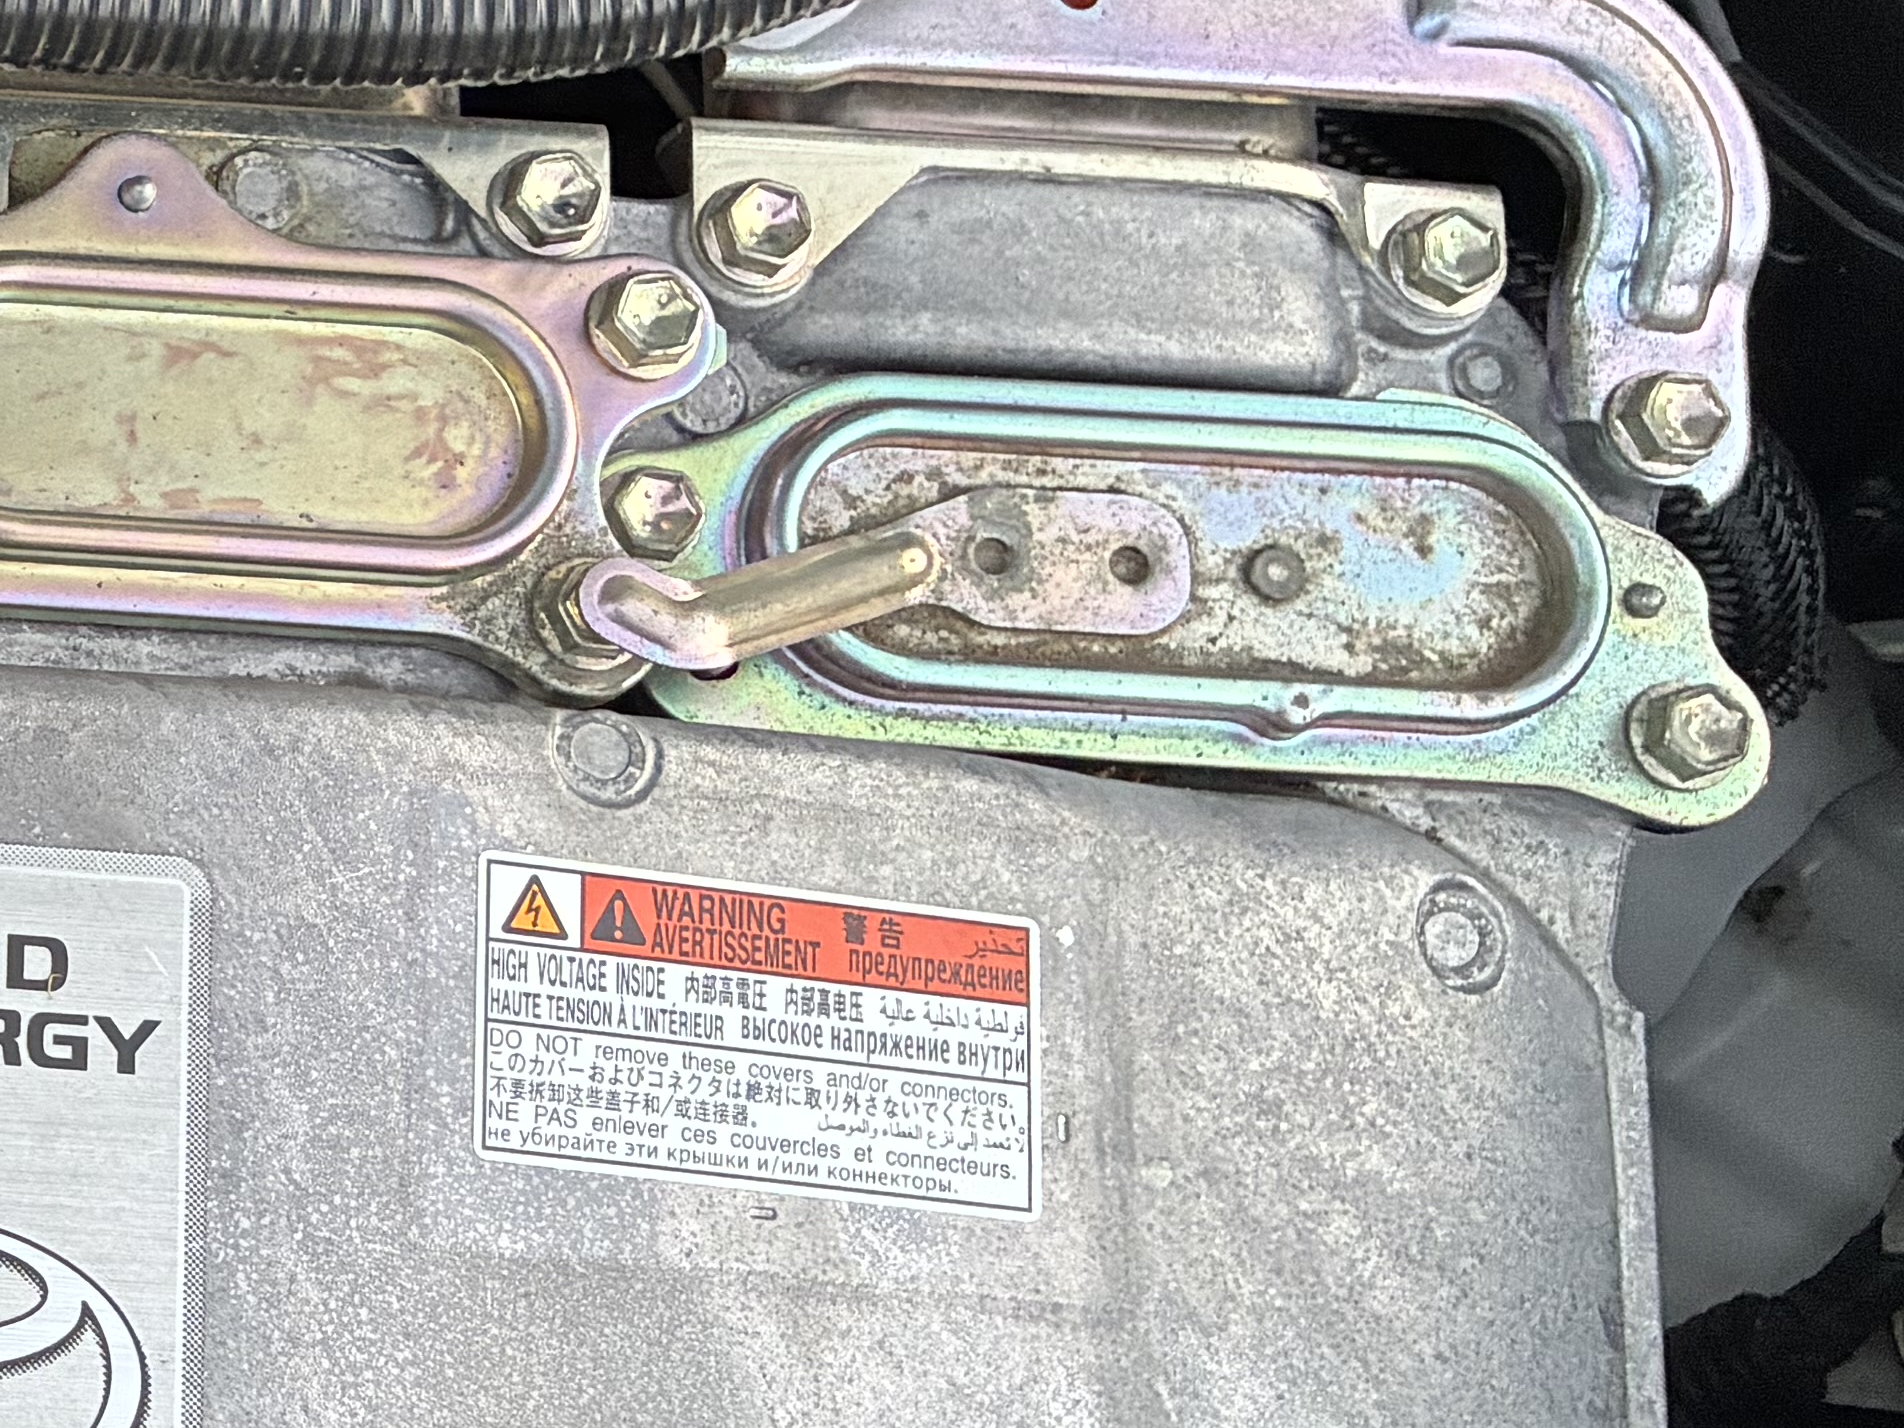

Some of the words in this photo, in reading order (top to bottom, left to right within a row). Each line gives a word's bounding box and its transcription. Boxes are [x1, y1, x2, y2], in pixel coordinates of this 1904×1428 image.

[651, 886, 787, 936] WARNING
[841, 911, 903, 950] 警告
[491, 946, 527, 983] HIGH
[536, 953, 607, 993] VOLTAGE
[616, 964, 665, 1000] INSIDE
[651, 922, 820, 974] AVERTISSEMENT
[849, 946, 1024, 995] предупреждение
[490, 986, 541, 1019] HAUTE
[547, 994, 612, 1029] TENSION
[616, 995, 628, 1030] À
[632, 996, 723, 1041] L'INTÉRIEUR
[741, 1017, 823, 1050] высокое
[830, 1026, 951, 1072] напряжение
[958, 1041, 1026, 1082] внутри
[491, 1028, 522, 1051] DO
[535, 1033, 581, 1059] NOT
[594, 1041, 668, 1068] remove
[681, 1051, 735, 1076] these
[747, 1062, 813, 1085] covers
[826, 1069, 889, 1095] and/or
[900, 1078, 1015, 1109] connectors.
[487, 1100, 518, 1123] NE
[534, 1106, 577, 1129] PAS
[592, 1111, 667, 1141] enlever
[681, 1124, 716, 1147] ces
[730, 1128, 840, 1161] couvercles
[853, 1142, 873, 1166] et
[885, 1147, 1016, 1182] connecteurs.
[487, 1125, 510, 1143] не
[519, 1124, 616, 1156] убирайте
[624, 1140, 658, 1160] эти
[666, 1145, 749, 1173] крышки
[757, 1155, 819, 1180] и/или
[828, 1163, 958, 1197] коннекторы.
